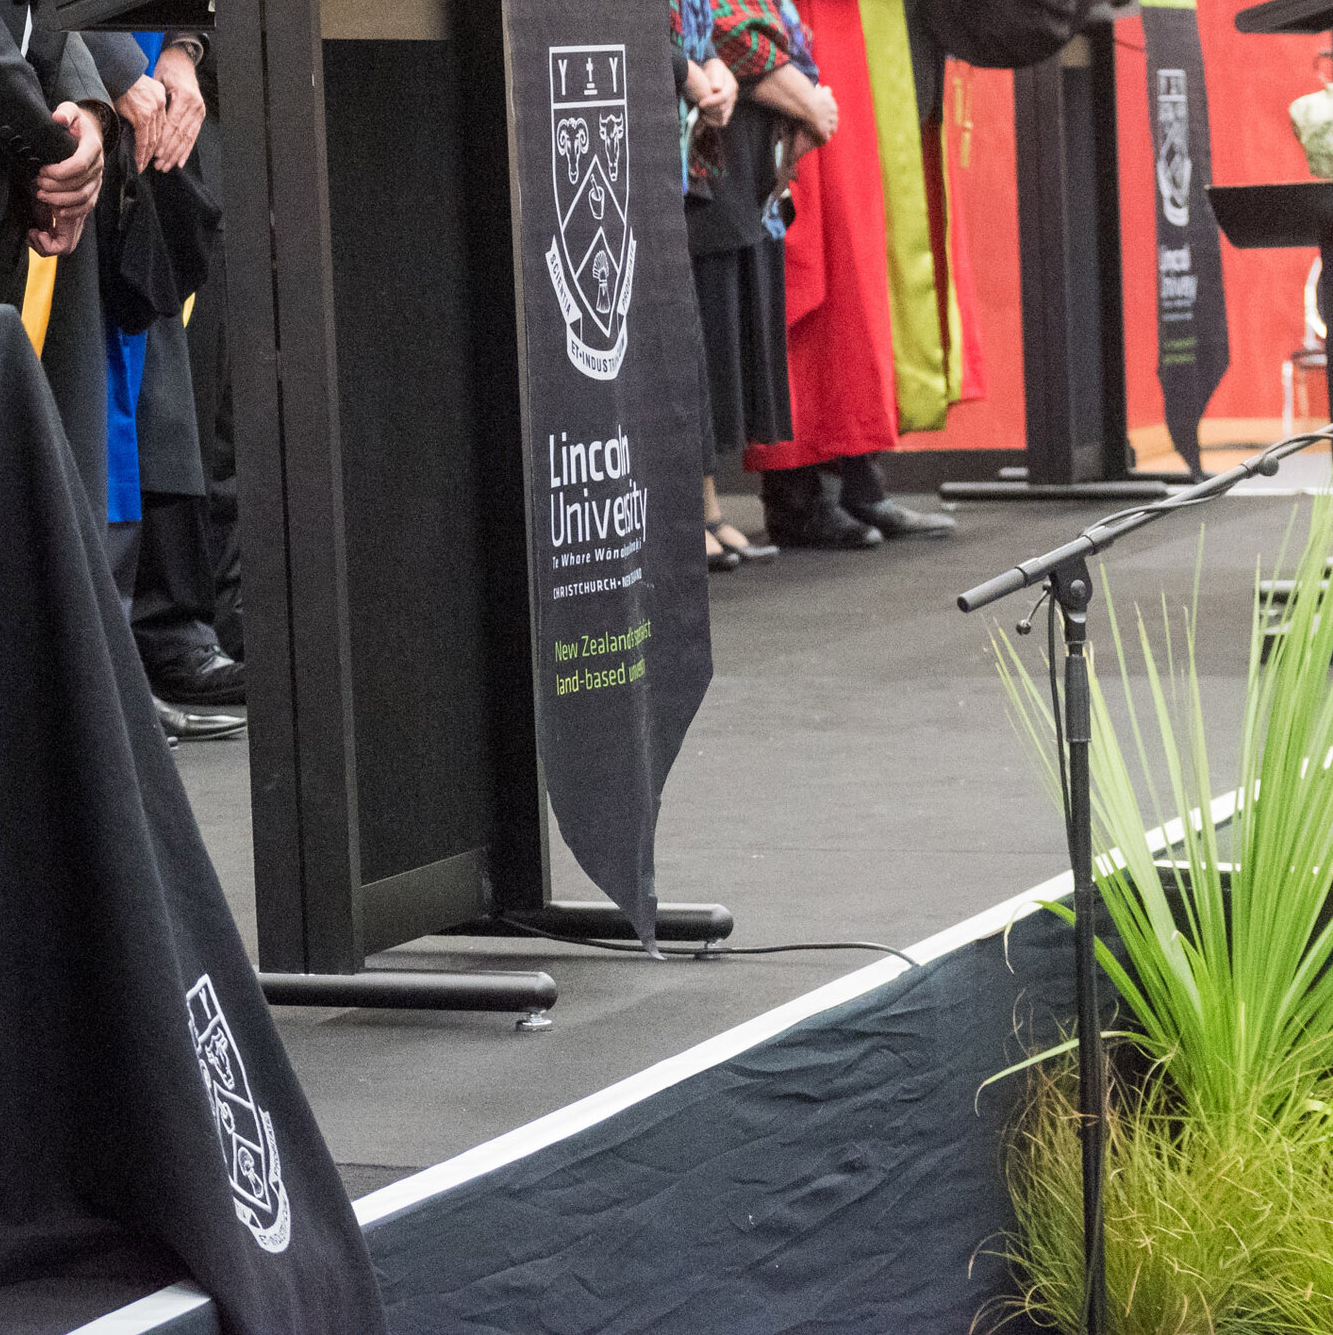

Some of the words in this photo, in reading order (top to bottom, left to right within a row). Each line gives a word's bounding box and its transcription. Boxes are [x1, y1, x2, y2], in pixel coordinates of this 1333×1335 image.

[549, 253, 571, 316] SCIENTIA
[549, 424, 631, 488] Lincoln
[550, 479, 647, 547] University
[561, 552, 591, 567] Whare
[554, 577, 617, 599] CHRISTCHURCH
[555, 640, 578, 662] New
[581, 627, 634, 657] Zealands
[556, 662, 626, 695] land-based
